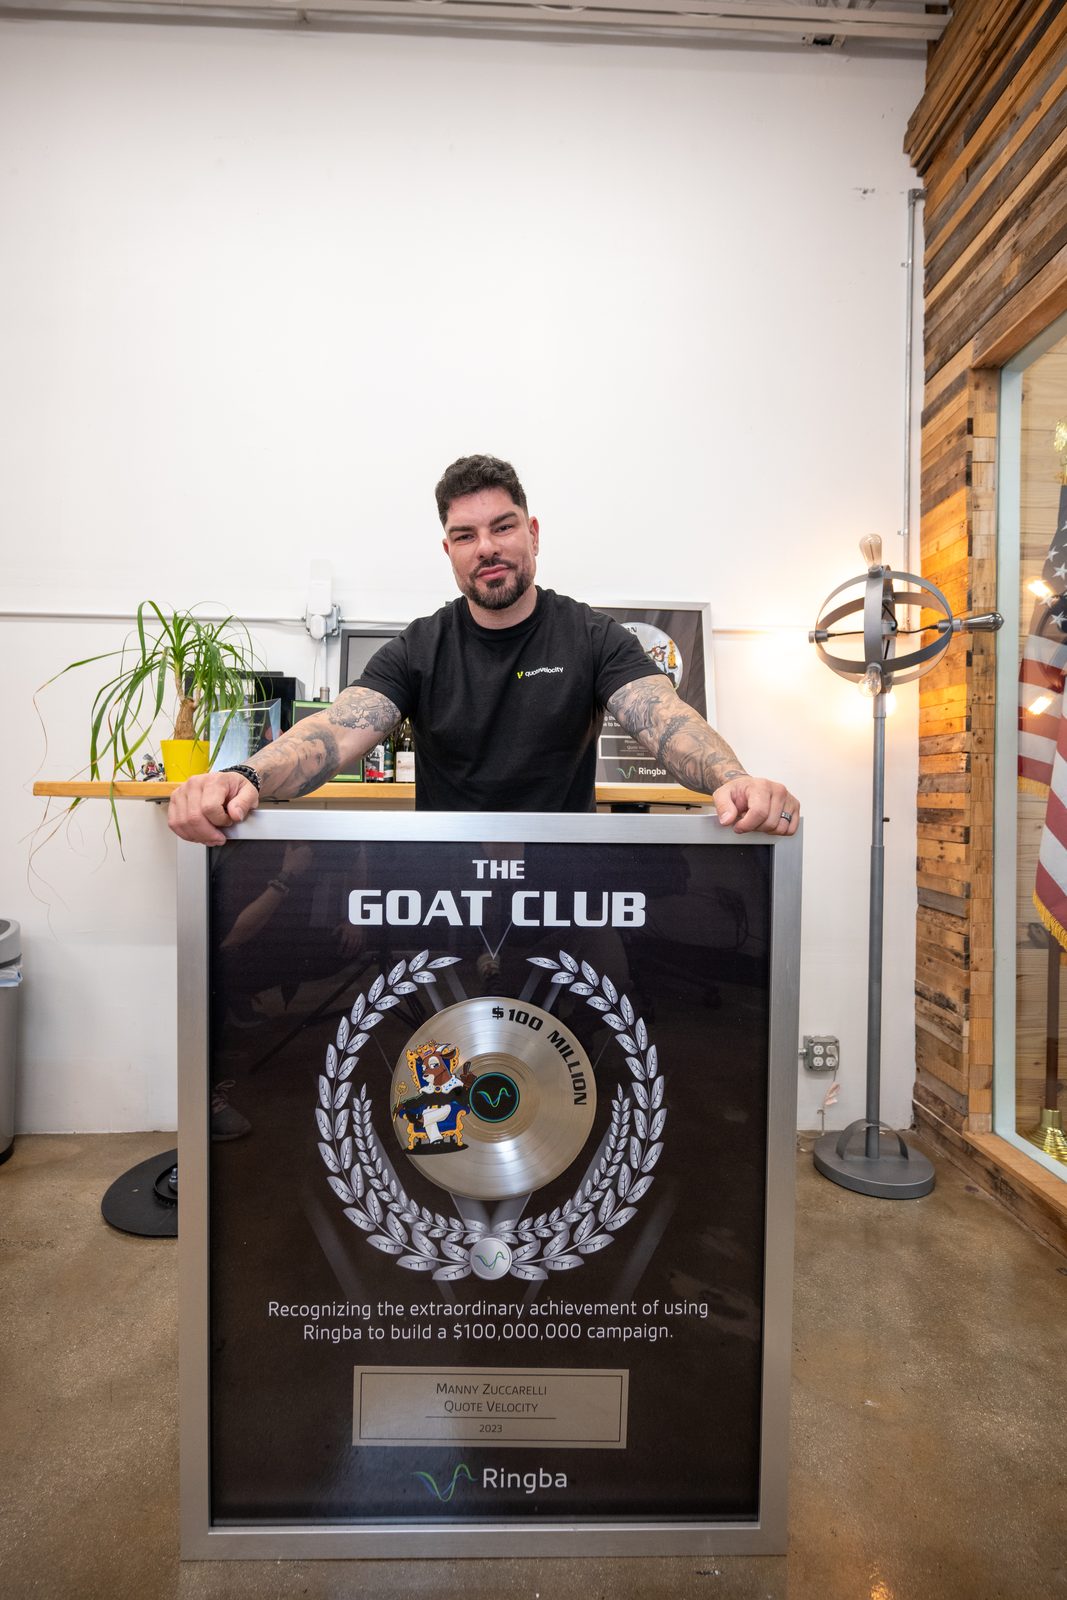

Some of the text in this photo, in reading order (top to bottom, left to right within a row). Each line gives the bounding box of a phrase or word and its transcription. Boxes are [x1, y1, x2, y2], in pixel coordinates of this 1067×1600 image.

[638, 767, 667, 777] Ringba
[472, 859, 525, 880] THE
[348, 889, 646, 927] GOAT CLUB
[491, 1006, 587, 1106] $100 MILLION
[268, 1299, 708, 1321] Recognizing the extraordinary achievement of using
[303, 1322, 673, 1344] Ringba to build a $100,000,000 campaign.
[436, 1383, 547, 1396] MANNY ZUCCARELLI
[444, 1400, 539, 1413] QUOTE VELOCITY
[479, 1424, 503, 1433] 2023
[483, 1467, 567, 1494] Ringba
